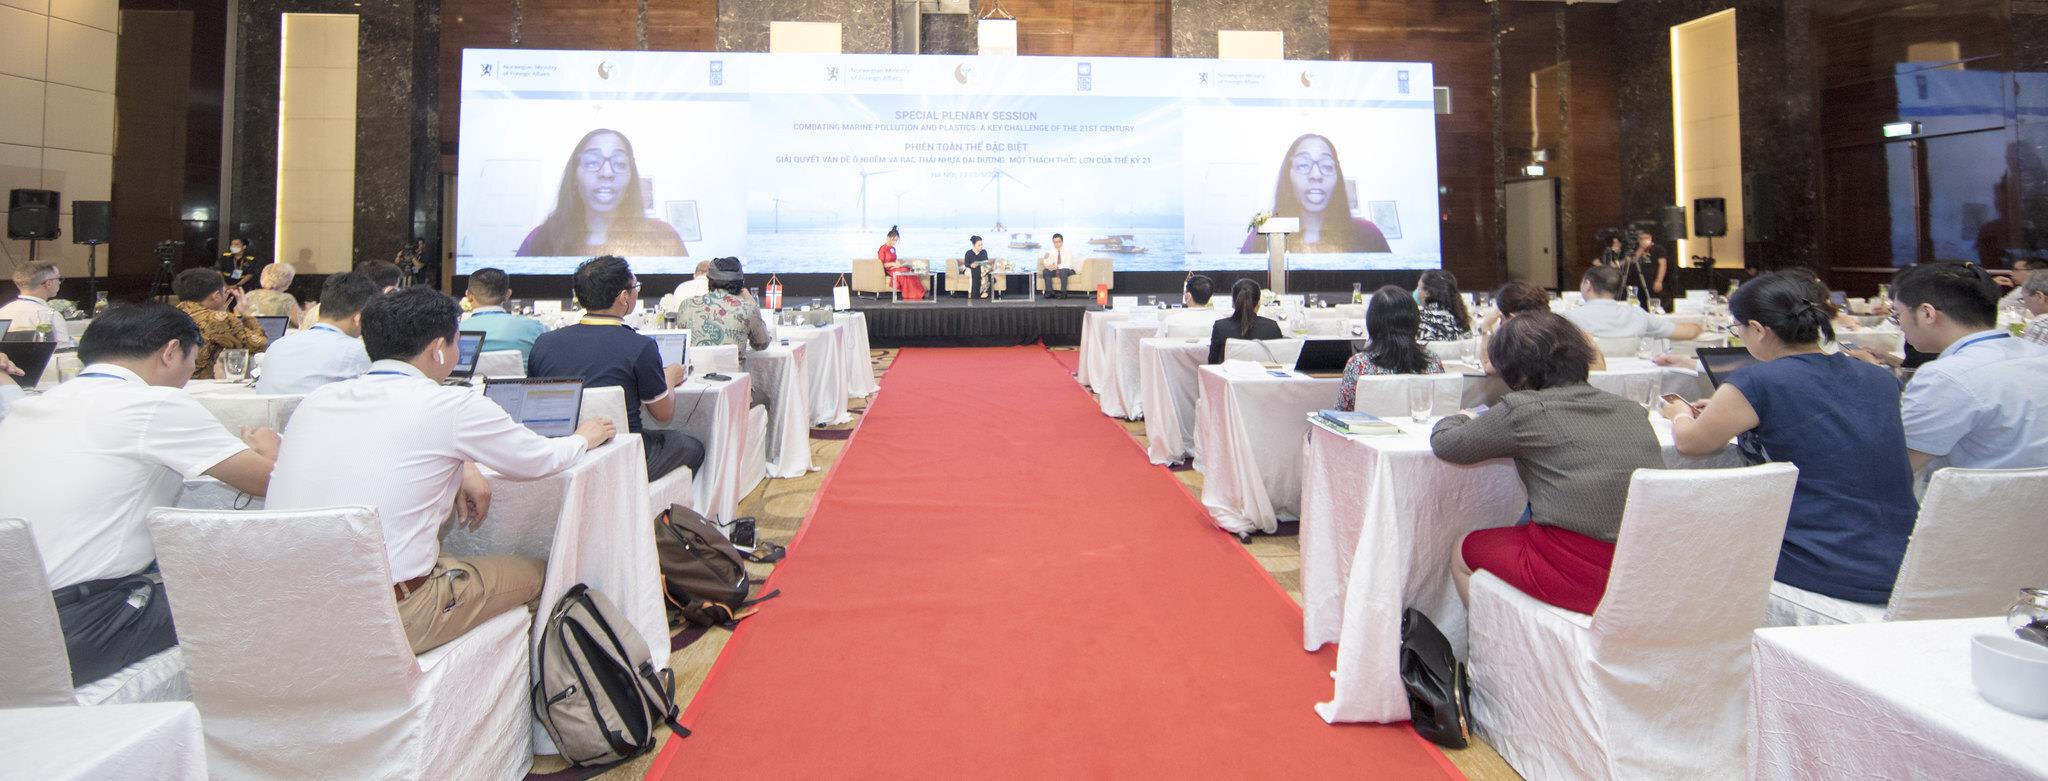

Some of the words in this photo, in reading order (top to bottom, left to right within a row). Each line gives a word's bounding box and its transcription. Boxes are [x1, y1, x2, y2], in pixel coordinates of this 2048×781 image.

[895, 111, 939, 120] SPECIAL
[942, 111, 990, 121] PLENARY
[992, 111, 1038, 121] SESSION
[793, 123, 840, 131] COMBATING
[842, 123, 873, 131] MARINE
[875, 123, 919, 131] POLLUTION
[921, 124, 937, 132] AND
[980, 124, 986, 132] A
[988, 124, 1003, 132] KEY
[1004, 124, 1049, 132] CHALLENGE
[1051, 124, 1062, 132] OF
[1063, 124, 1078, 132] THE
[1079, 124, 1097, 132] 21ST
[1099, 124, 1135, 132] CENTURY
[905, 141, 935, 152] PHIÊN
[1142, 155, 1151, 164] 21
